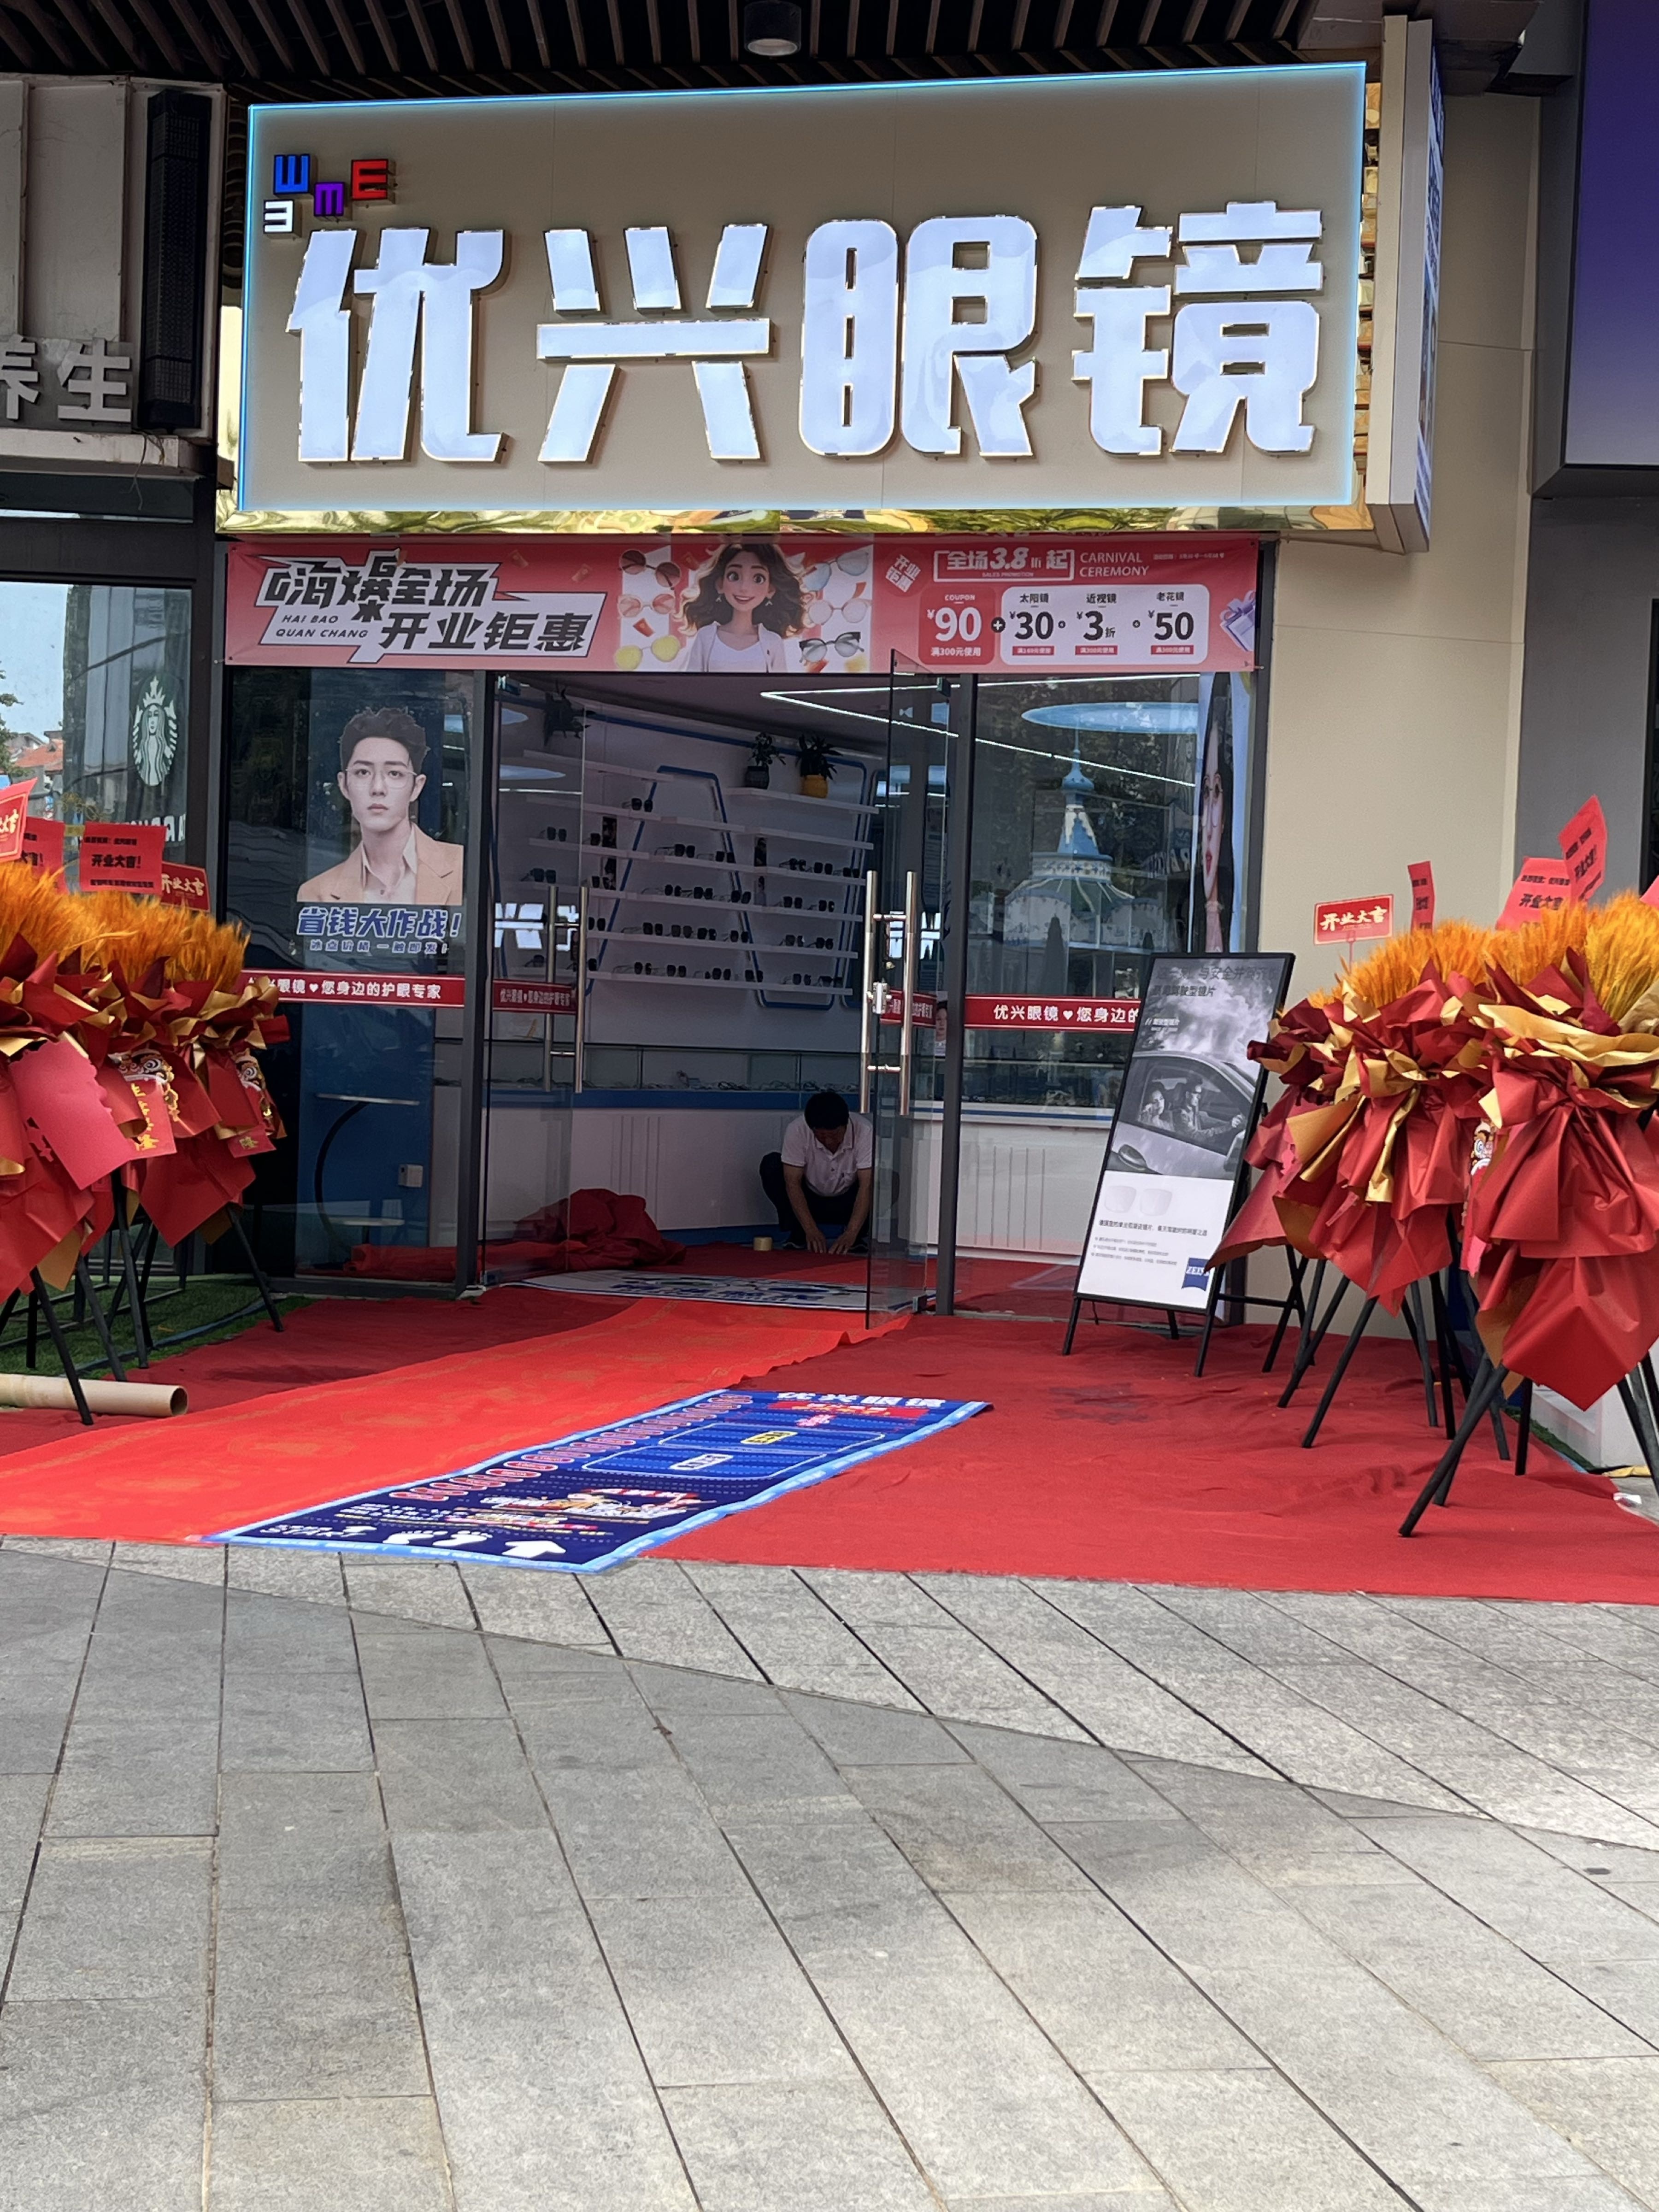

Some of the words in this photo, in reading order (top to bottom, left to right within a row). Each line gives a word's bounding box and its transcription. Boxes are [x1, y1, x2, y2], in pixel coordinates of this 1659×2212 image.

[286, 200, 1324, 463] 优兴眼镜
[1080, 552, 1143, 563] CARNIVAL
[1079, 566, 1149, 577] CEREMONY
[281, 614, 307, 624] HAI
[310, 615, 339, 624] BAO
[276, 628, 316, 637] QUAN
[319, 629, 369, 638] CHANG
[378, 611, 593, 652] 开业钜惠
[1319, 905, 1388, 931] 开业大吉
[321, 980, 441, 999] 您身边的护眼专家
[993, 1004, 1059, 1022] 优兴眼镜
